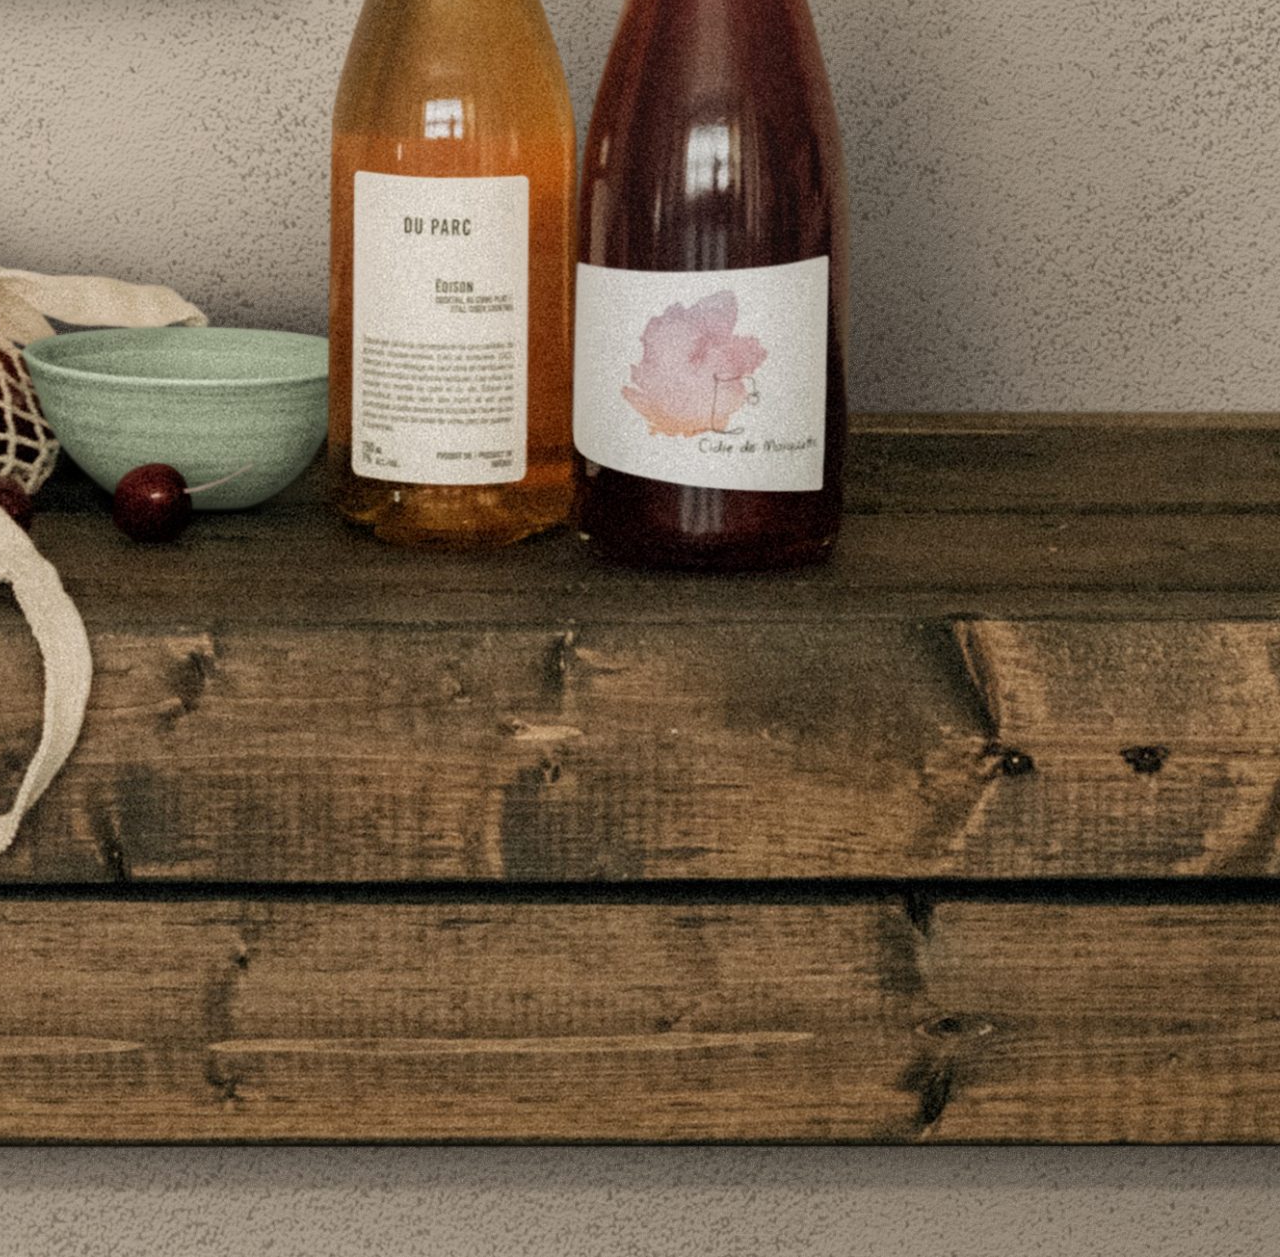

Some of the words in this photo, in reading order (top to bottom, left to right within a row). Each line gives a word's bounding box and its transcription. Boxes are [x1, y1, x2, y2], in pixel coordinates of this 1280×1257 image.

[404, 216, 423, 235] DU
[431, 218, 472, 236] PARC
[739, 440, 756, 454] de
